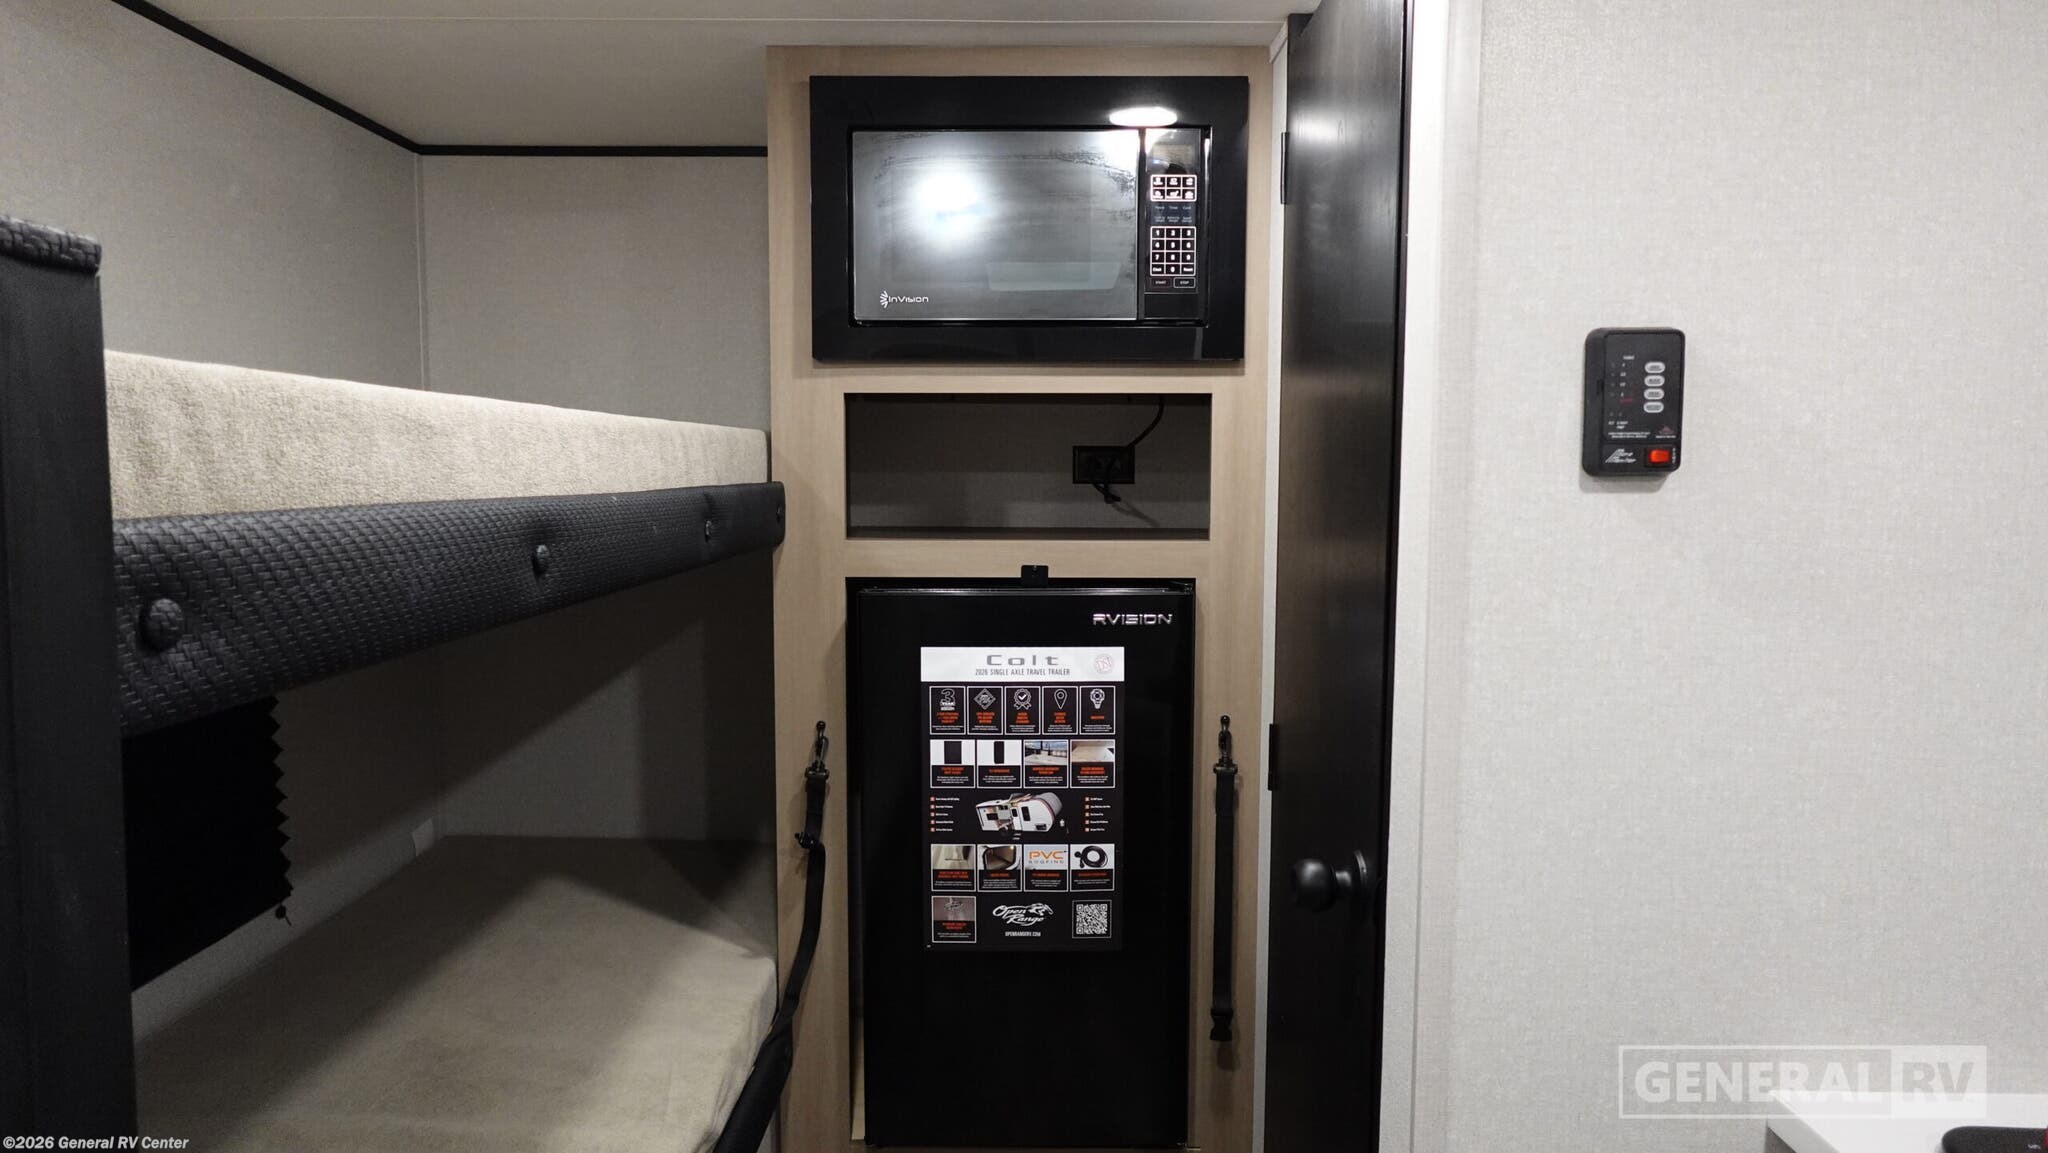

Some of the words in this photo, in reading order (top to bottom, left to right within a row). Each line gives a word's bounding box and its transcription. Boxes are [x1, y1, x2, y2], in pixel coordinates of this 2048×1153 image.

[1092, 613, 1173, 626] RVISION
[986, 654, 1059, 666] Colt
[990, 668, 1009, 676] SINGLE
[1011, 668, 1025, 676] AXLE
[1026, 668, 1046, 676] TRAVEL
[1048, 668, 1071, 676] TRAILER
[1029, 850, 1064, 860] PVC
[992, 904, 1026, 919] Open
[1006, 914, 1045, 925] Range
